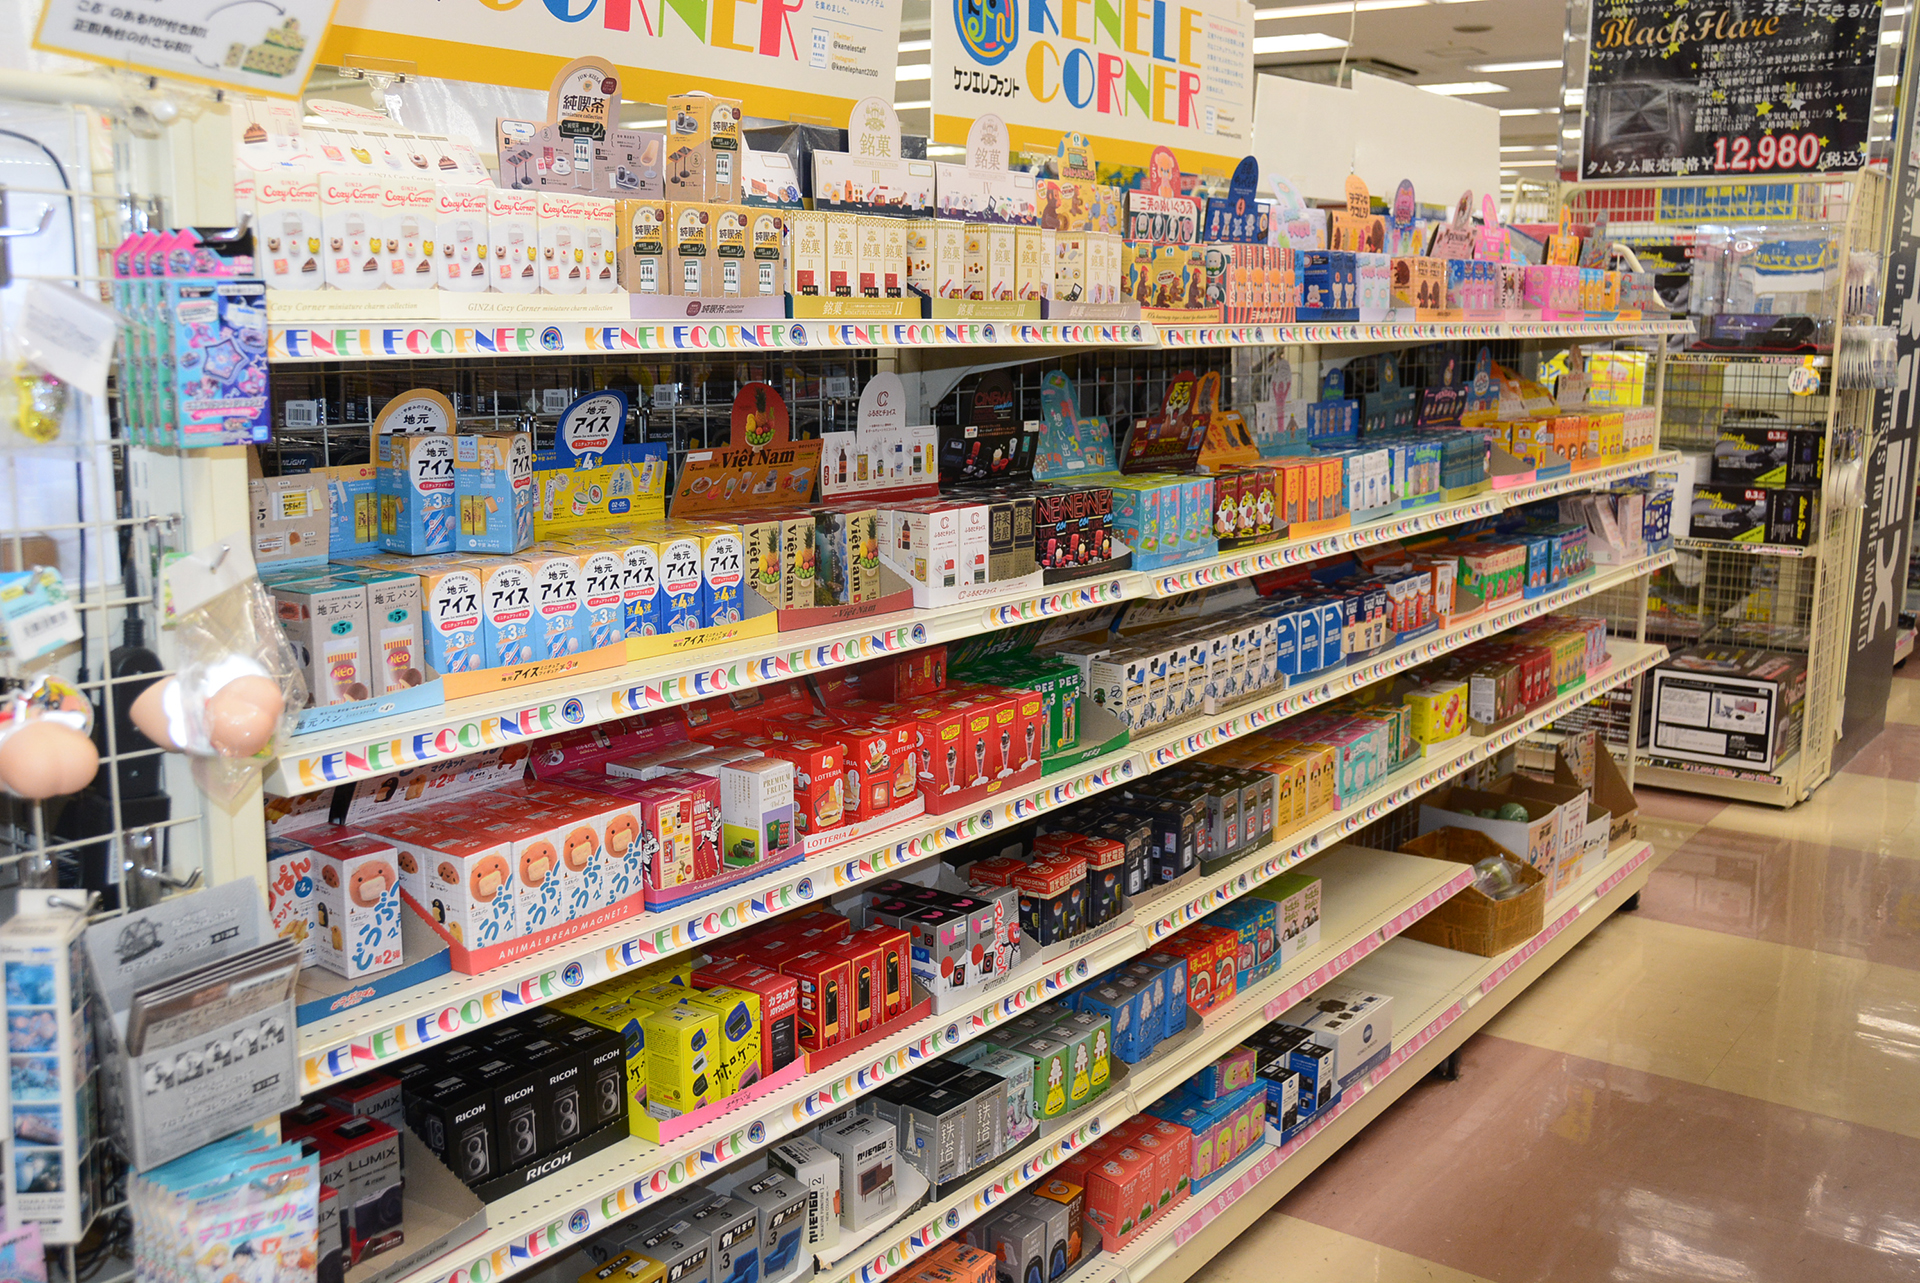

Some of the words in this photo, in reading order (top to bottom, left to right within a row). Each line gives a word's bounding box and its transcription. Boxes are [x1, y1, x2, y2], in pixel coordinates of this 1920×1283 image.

[1028, 0, 1202, 69] KENELE
[1596, 13, 1690, 50] Black
[1690, 10, 1780, 44] Flare
[953, 65, 1020, 99] ケンエレファント
[1025, 40, 1201, 130] CORNER
[562, 94, 606, 115] 純喫茶
[712, 120, 736, 133] 純喫茶
[859, 132, 892, 158] 銘菓
[1586, 154, 1700, 174] タムタム販売価格
[634, 225, 660, 237] 純喫茶
[679, 226, 704, 238] 純喫茶
[719, 228, 743, 240] 純喫茶
[755, 231, 778, 243] 純喫茶
[468, 302, 495, 313] GINZA
[496, 303, 515, 314] Cozy
[516, 304, 541, 313] Corner
[542, 305, 570, 313] miniature
[570, 305, 586, 313] charm
[586, 304, 614, 313] collection
[701, 303, 725, 314] 純喫茶
[822, 301, 844, 316] 銘菓
[956, 302, 976, 317] 銘菓
[585, 405, 607, 415] 地元
[403, 413, 430, 426] 地元
[574, 415, 611, 434] アイス
[426, 447, 449, 458] 地元
[722, 451, 754, 472] Việt
[757, 450, 794, 465] Nam
[417, 457, 455, 477] アイス
[1872, 473, 1885, 501] IN
[850, 516, 861, 552] Việt
[1866, 507, 1882, 554] THE
[716, 544, 733, 556] 地元
[786, 524, 797, 559] Việt
[666, 561, 698, 580] アイス
[710, 554, 740, 573] アイス
[852, 553, 861, 592] Nam
[786, 560, 796, 602] Nam
[374, 588, 418, 606] 地元パン
[446, 584, 469, 597] 地元
[492, 588, 530, 609] アイス
[317, 600, 364, 616] 地元パン
[439, 594, 478, 617] アイス
[855, 604, 877, 615] Nam
[1856, 558, 1876, 652] WORLD
[682, 634, 706, 647] アイス
[513, 666, 539, 682] アイス
[1058, 674, 1079, 689] PEZ
[1035, 680, 1054, 693] PEZ
[1074, 685, 1080, 698] 3
[891, 743, 916, 756] LOTTERIA
[430, 758, 466, 773] マグネット
[428, 773, 457, 789] 第2弾
[762, 770, 792, 789] PREMIUM
[814, 768, 842, 783] LOTTERIA
[765, 782, 789, 796] FRUITS
[807, 831, 848, 849] LOTTERIA
[497, 941, 542, 960] ANIMAL
[544, 924, 578, 945] BREAD
[580, 909, 623, 931] MAGNET
[622, 904, 629, 914] 2
[374, 949, 401, 966] 第2弾
[1301, 973, 1319, 988] 食玩
[768, 986, 797, 1007] カラオケ
[769, 997, 797, 1017] JOYSOUND
[593, 1048, 620, 1066] RICOH
[550, 1066, 578, 1086] RICOH
[504, 1084, 535, 1105] RICOH
[357, 1095, 400, 1116] LUMIX
[455, 1102, 486, 1124] RICOH
[349, 1146, 397, 1172] LUMIX
[526, 1151, 572, 1182] RICOH
